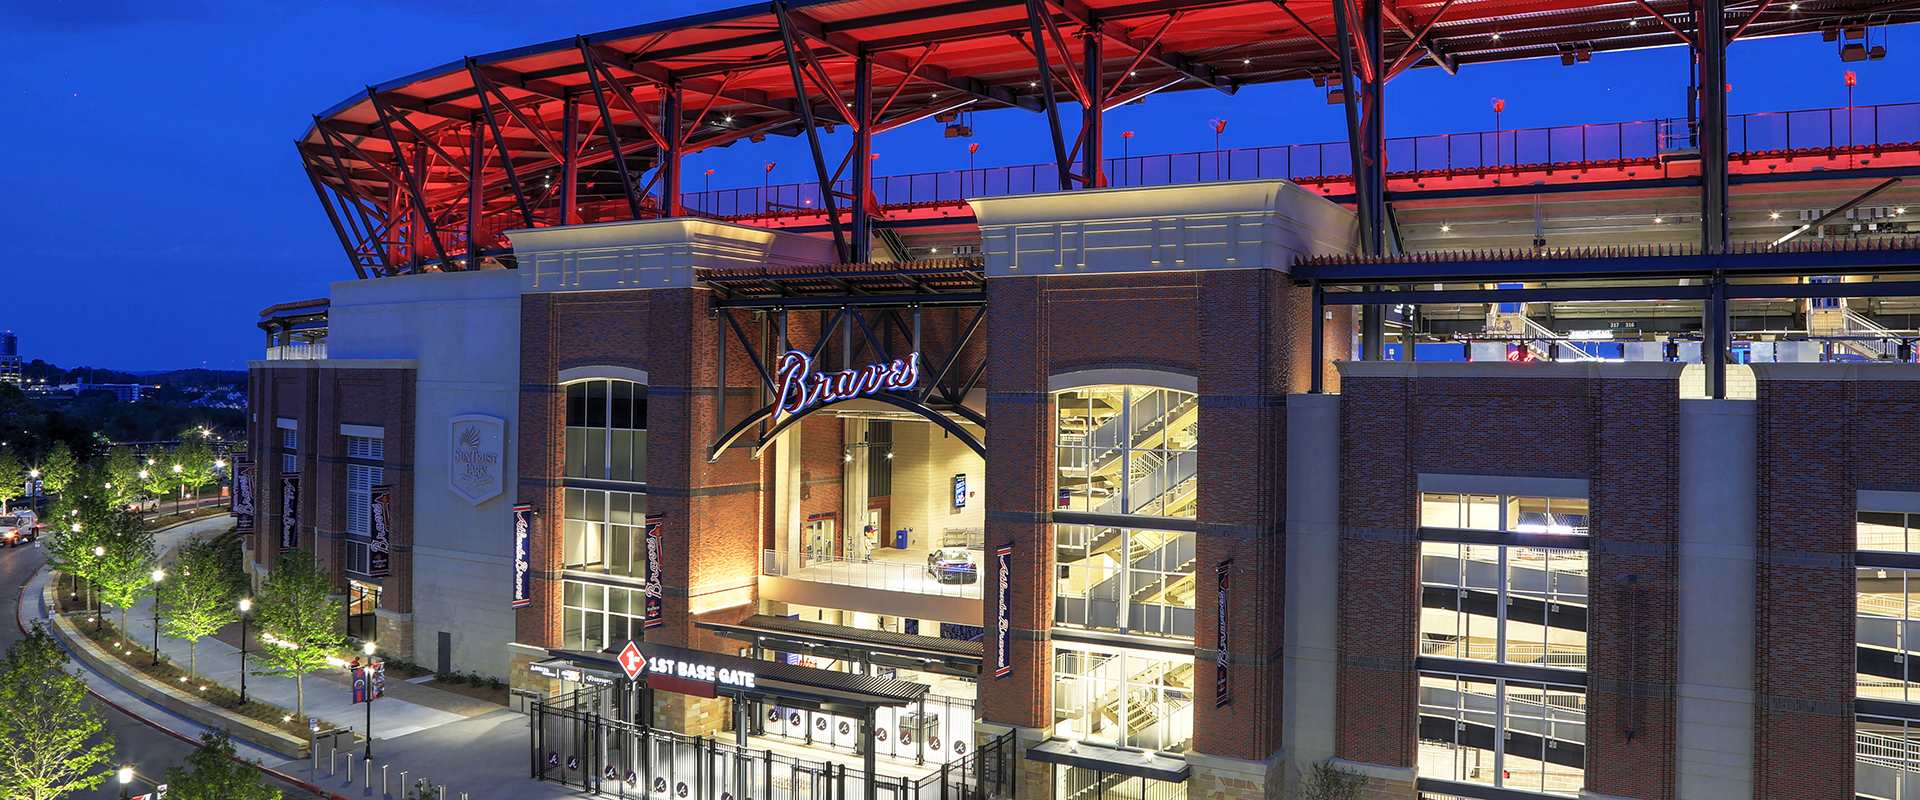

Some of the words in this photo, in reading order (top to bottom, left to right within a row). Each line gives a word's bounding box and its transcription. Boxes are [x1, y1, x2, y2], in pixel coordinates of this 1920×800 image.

[771, 349, 920, 420] Braves
[370, 503, 390, 554] Braves
[515, 511, 529, 560] Atlanta
[514, 558, 529, 600] Braves
[645, 537, 662, 599] Braves
[999, 555, 1009, 617] Atlanta
[649, 656, 675, 675] 1ST
[677, 661, 716, 682] BASE
[718, 668, 756, 688] GATE
